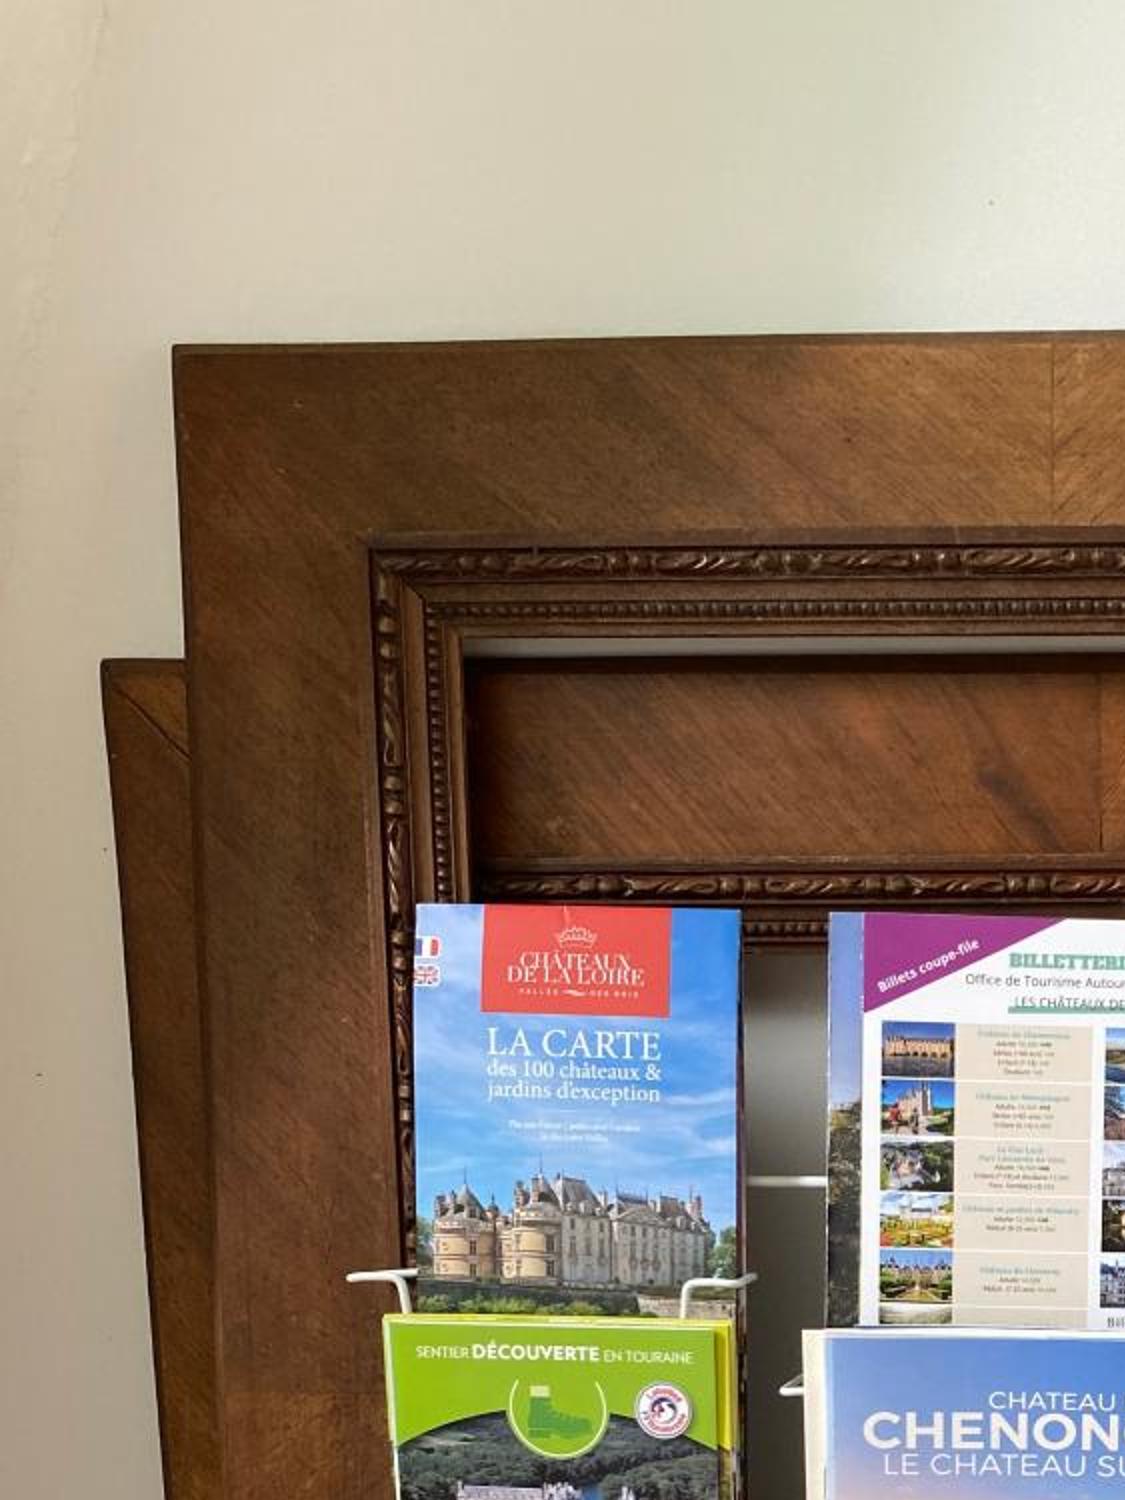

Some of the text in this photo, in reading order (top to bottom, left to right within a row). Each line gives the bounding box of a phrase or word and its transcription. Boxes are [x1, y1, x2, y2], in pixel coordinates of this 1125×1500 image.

[508, 965, 645, 987] DE LA LOIRE
[878, 938, 979, 992] Billets coupe-file
[965, 974, 1001, 986] Office
[1006, 976, 1020, 987] de
[1025, 976, 1081, 988] Tourisme
[1015, 997, 1034, 1009] LES
[1110, 999, 1124, 1011] DE
[487, 1027, 661, 1061] LA CARTE
[487, 1060, 661, 1081] des 100 châteaux &
[487, 1080, 660, 1106] jardins d'exception
[416, 1339, 694, 1364] SENTIER DÉCOUVERTE EN TOURAINE
[988, 1391, 1116, 1412] CHATEAU
[883, 1453, 918, 1476] LE
[930, 1453, 1085, 1477] CHATEAU
